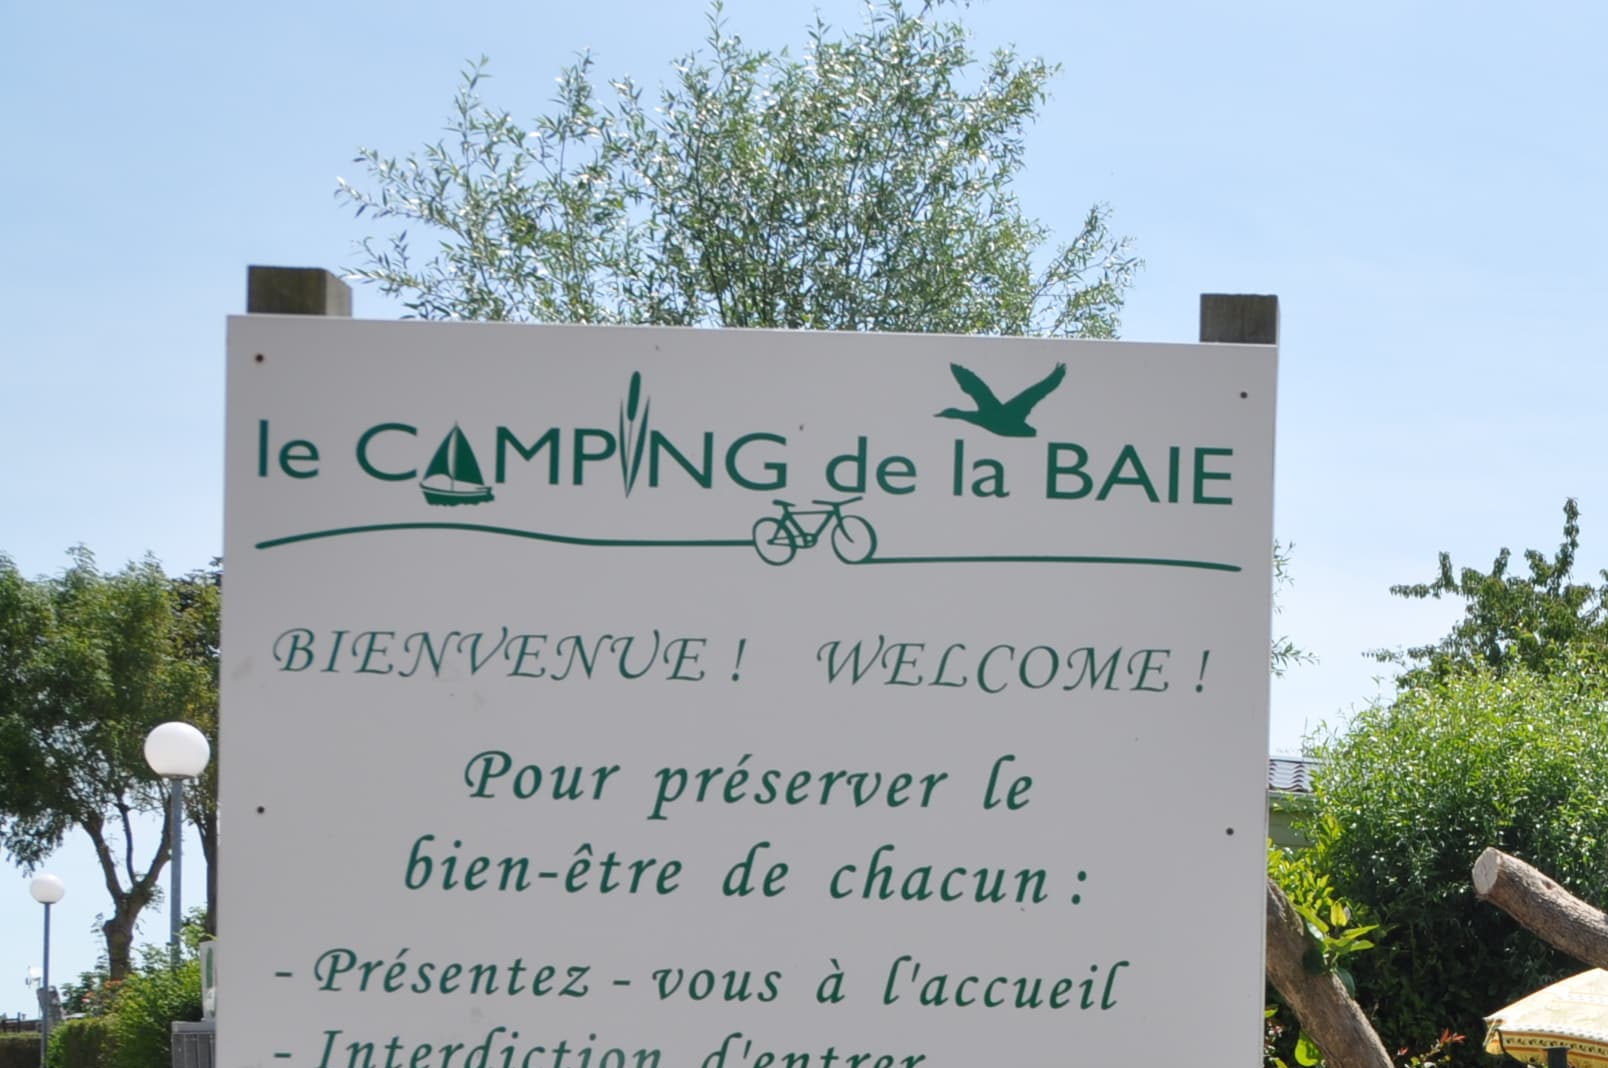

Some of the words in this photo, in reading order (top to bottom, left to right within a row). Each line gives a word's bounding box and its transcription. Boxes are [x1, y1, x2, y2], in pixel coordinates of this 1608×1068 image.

[256, 417, 322, 482] le
[824, 434, 919, 497] de
[951, 436, 1010, 499] la
[1044, 440, 1235, 507] BAIE
[271, 624, 708, 683] BIENVENUE
[815, 633, 1173, 695] WELCOME
[462, 748, 622, 802] Pour
[645, 752, 950, 822] préserver
[982, 752, 1034, 812] le
[403, 832, 684, 897] bien-être
[720, 839, 790, 899] de
[312, 946, 592, 999] Présentez
[653, 966, 784, 1004] vous
[814, 959, 847, 1006] à
[881, 953, 1130, 1011] l'accueil
